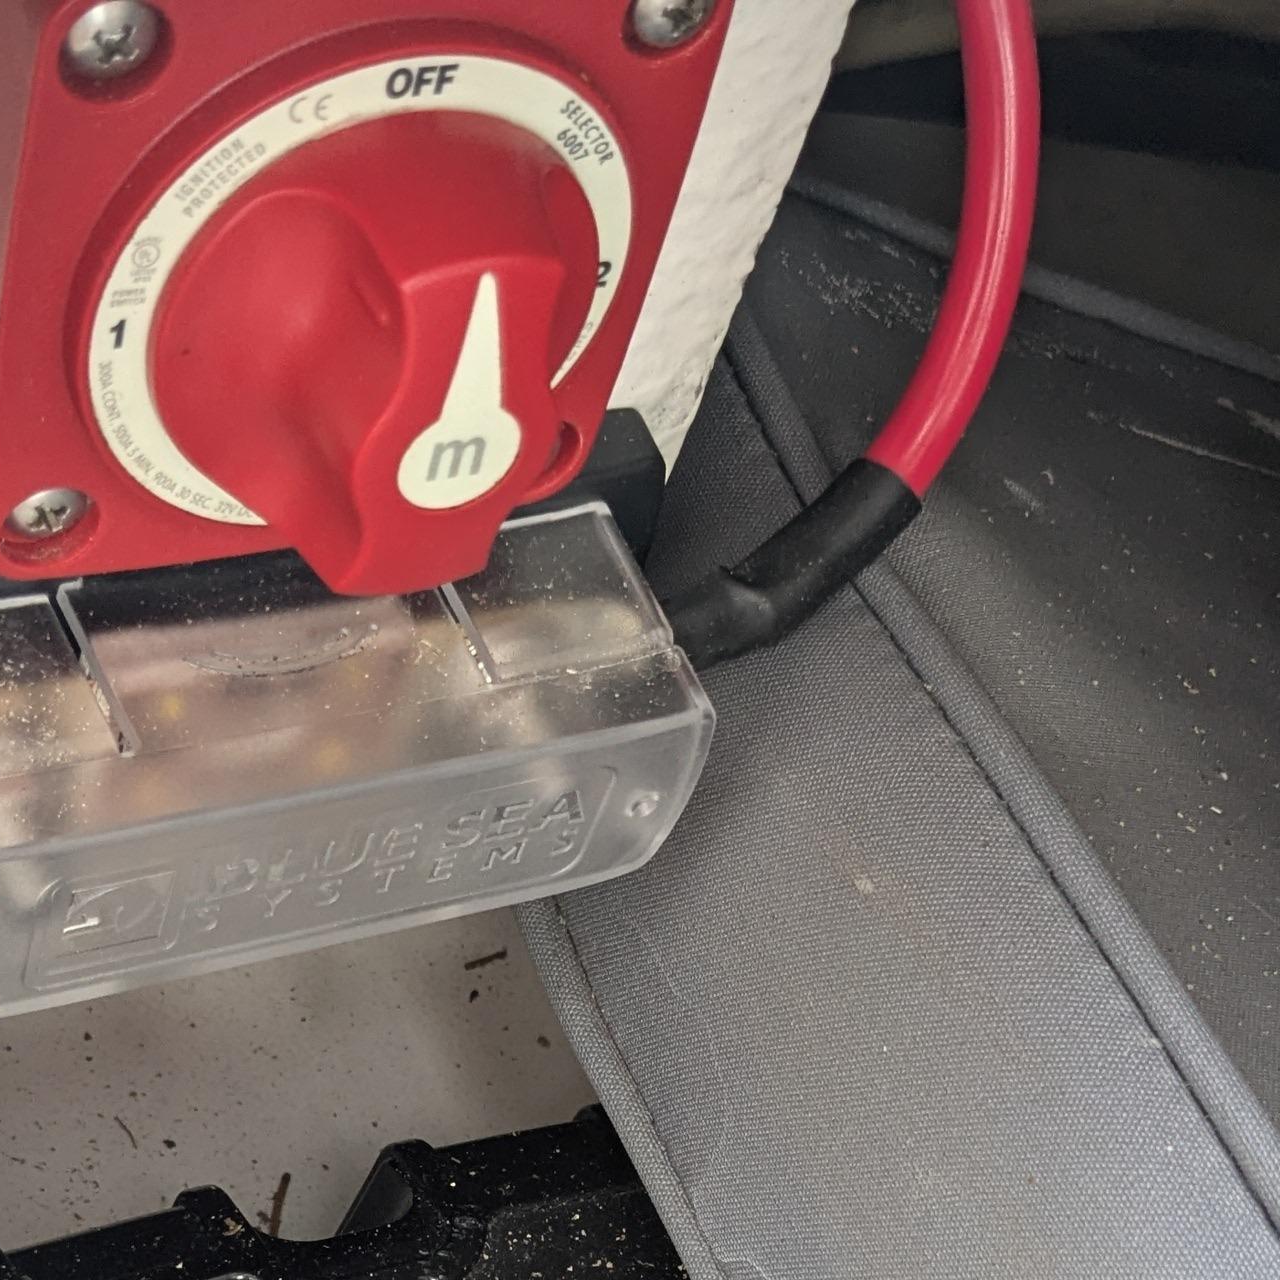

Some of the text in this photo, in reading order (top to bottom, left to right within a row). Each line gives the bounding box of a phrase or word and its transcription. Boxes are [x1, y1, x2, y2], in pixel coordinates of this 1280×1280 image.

[385, 64, 459, 99] OFF
[556, 128, 589, 162] 6007
[560, 99, 614, 166] SELECTOR
[174, 138, 245, 201] IGNITION
[182, 142, 267, 218] PROTECTED
[109, 318, 126, 349] 1
[425, 437, 486, 482] m
[212, 790, 586, 897] BLUE SEA
[194, 829, 579, 931] SYSTEMS
